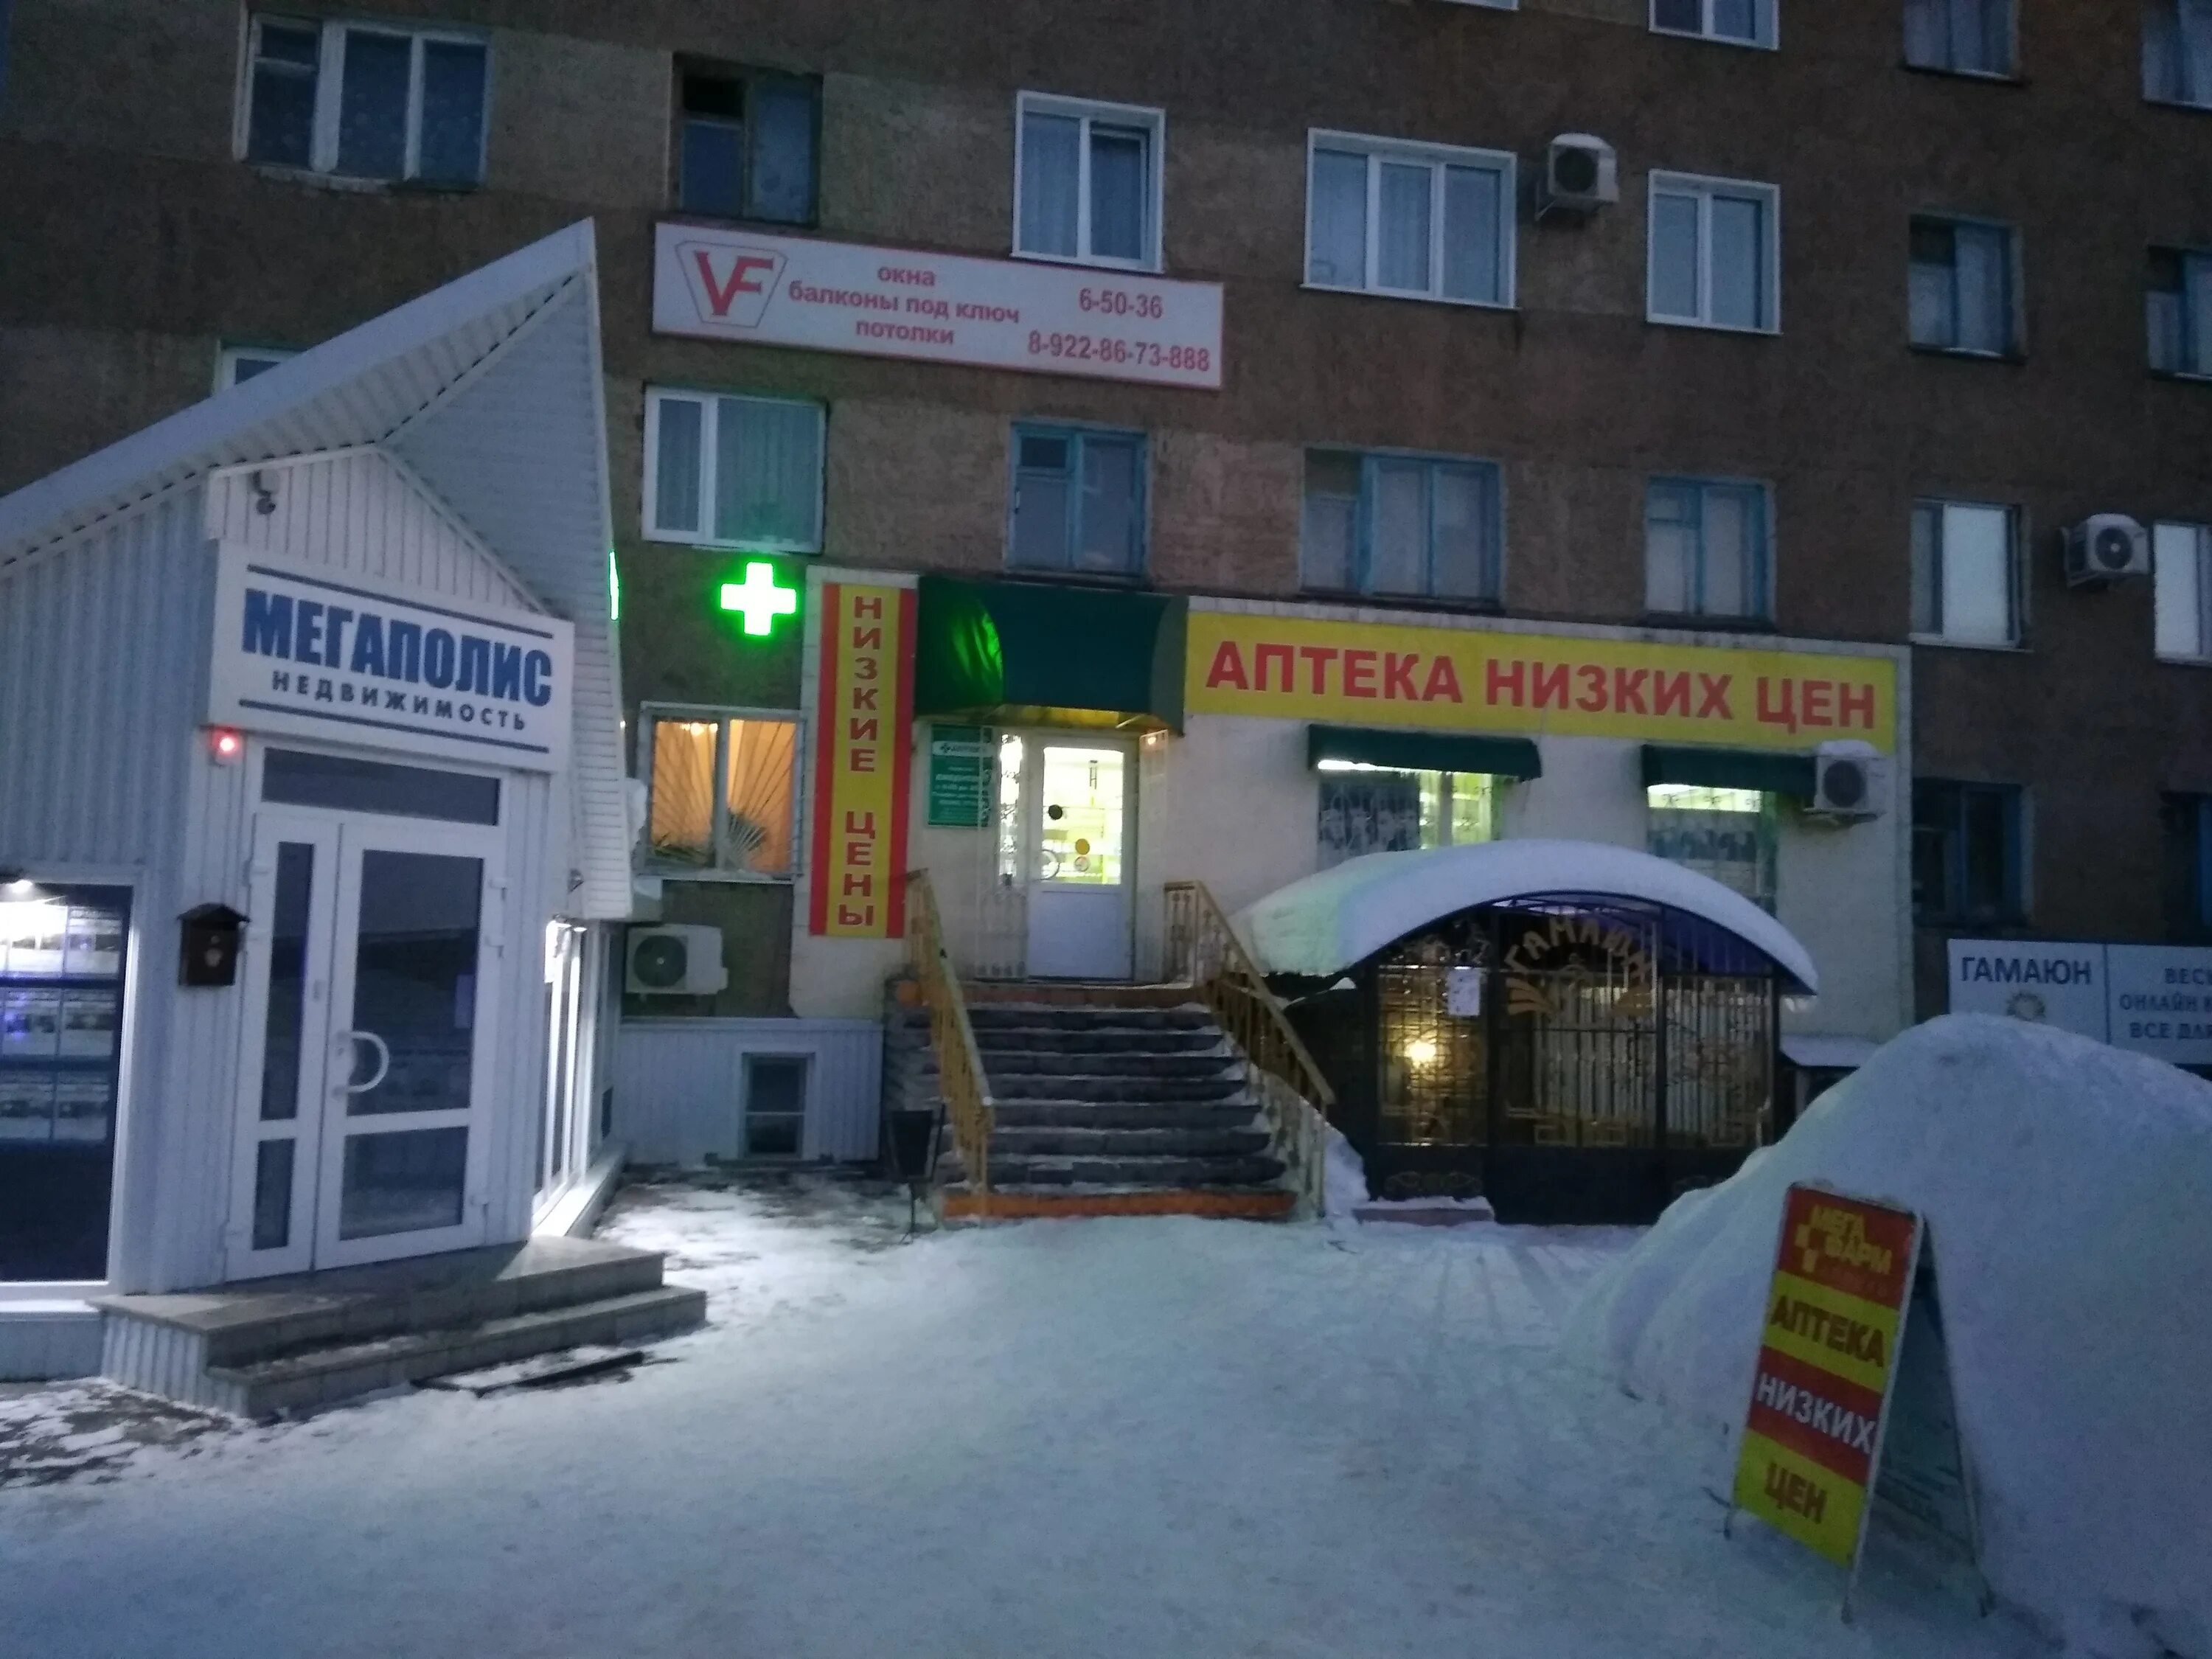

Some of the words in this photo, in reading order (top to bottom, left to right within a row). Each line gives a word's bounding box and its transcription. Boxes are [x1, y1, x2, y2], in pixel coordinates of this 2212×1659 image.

[694, 250, 773, 317] VF
[788, 280, 899, 312] балконы
[905, 296, 950, 319] под
[955, 302, 1020, 324] ключ
[877, 266, 935, 286] окна
[1079, 287, 1164, 319] 6-50-36
[855, 320, 955, 344] потолки
[1028, 330, 1211, 372] 8-922-86-73-888
[241, 588, 554, 707] МЕГАПОЛИС
[271, 670, 526, 731] НЕДВИЖИМОСТЬ
[849, 595, 883, 773] НИЗКИЕ
[1205, 640, 1464, 703] АПТЕКА
[1486, 658, 1735, 720] НИЗКИХ
[1756, 676, 1876, 734] ЦЕН
[838, 811, 877, 927] ЦЕНЫ
[1961, 956, 2093, 985] ГАМАЮН
[2129, 1022, 2171, 1039] ВСЕ
[1770, 1295, 1884, 1367] АПТЕКА
[1756, 1371, 1877, 1455] НИЗКИХ
[1763, 1462, 1828, 1525] ЦЕН
